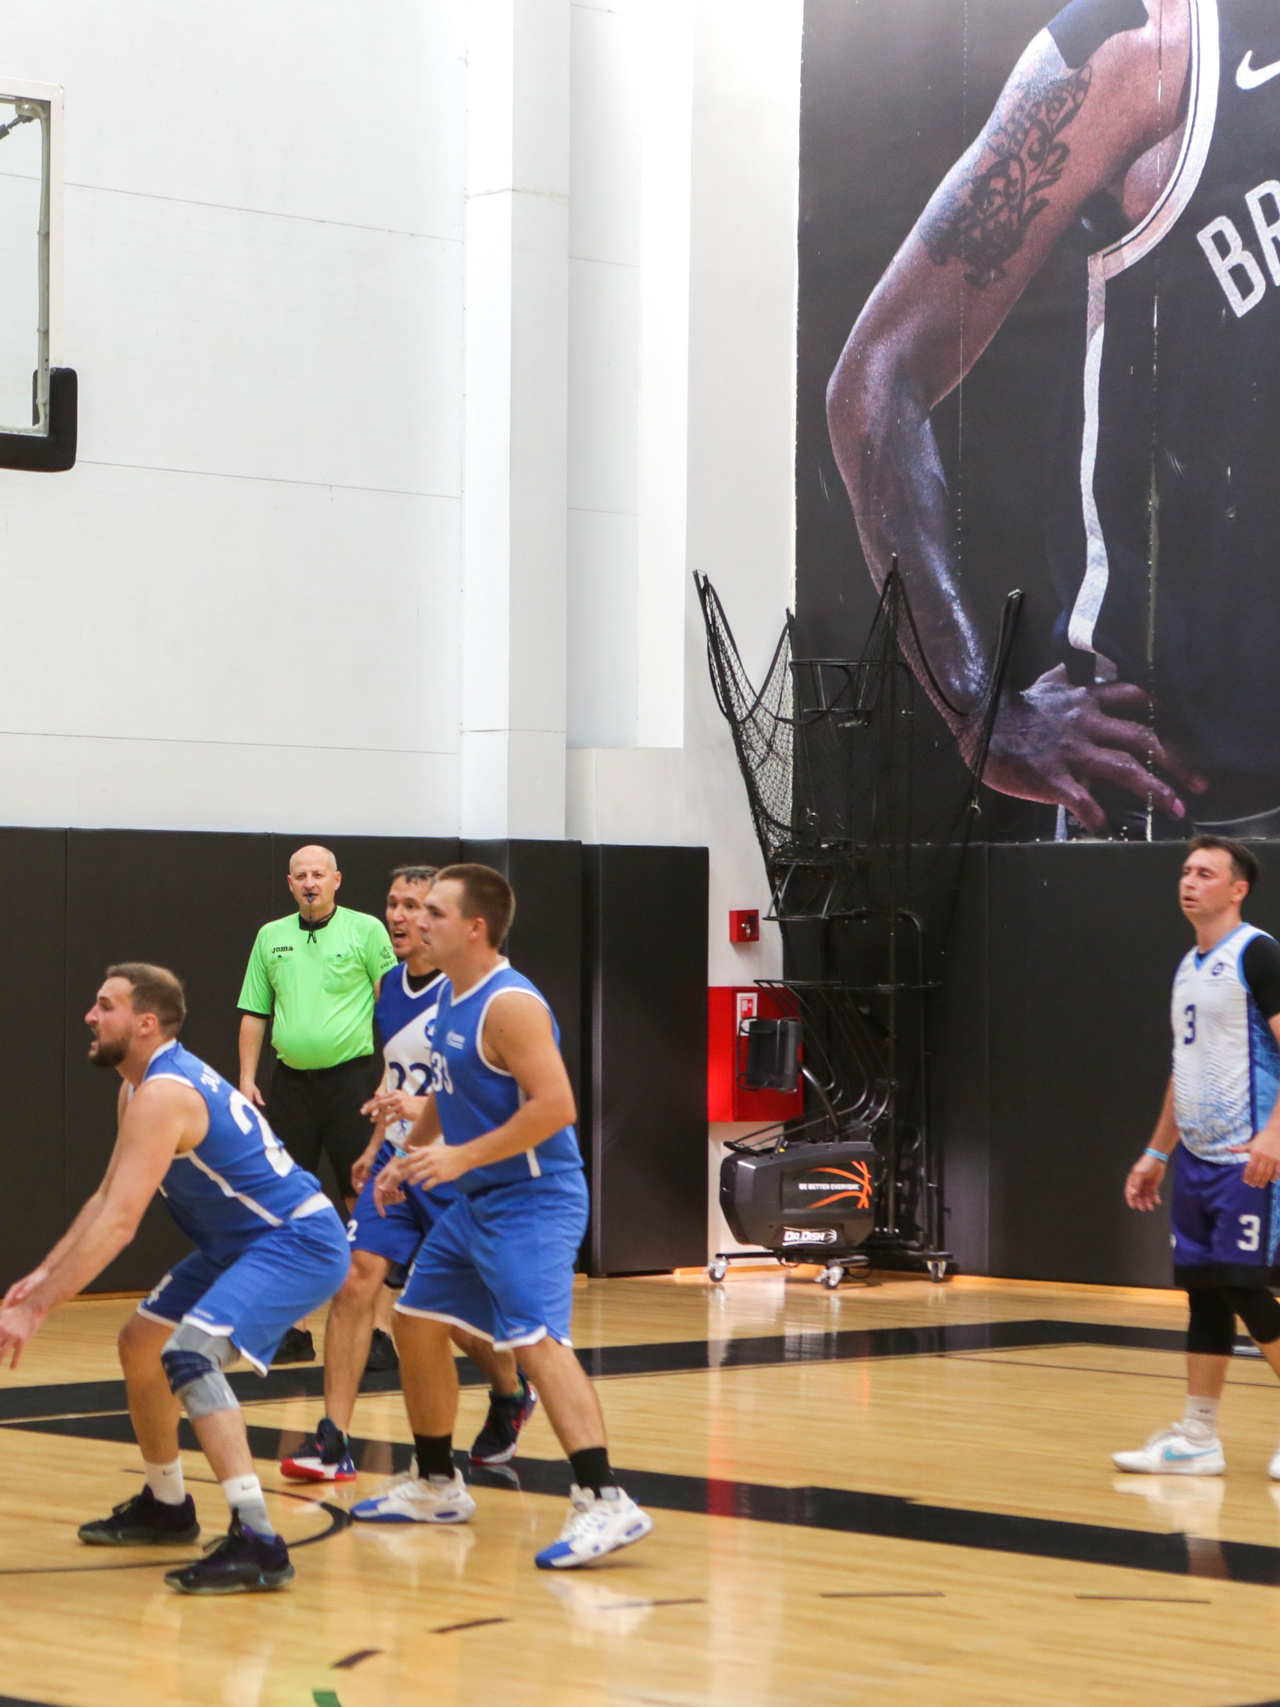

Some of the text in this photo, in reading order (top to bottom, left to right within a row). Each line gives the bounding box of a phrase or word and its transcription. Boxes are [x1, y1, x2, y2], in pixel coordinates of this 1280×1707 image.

[1183, 1004, 1196, 1045] 3
[346, 1219, 358, 1242] 2
[1237, 1214, 1261, 1251] 3
